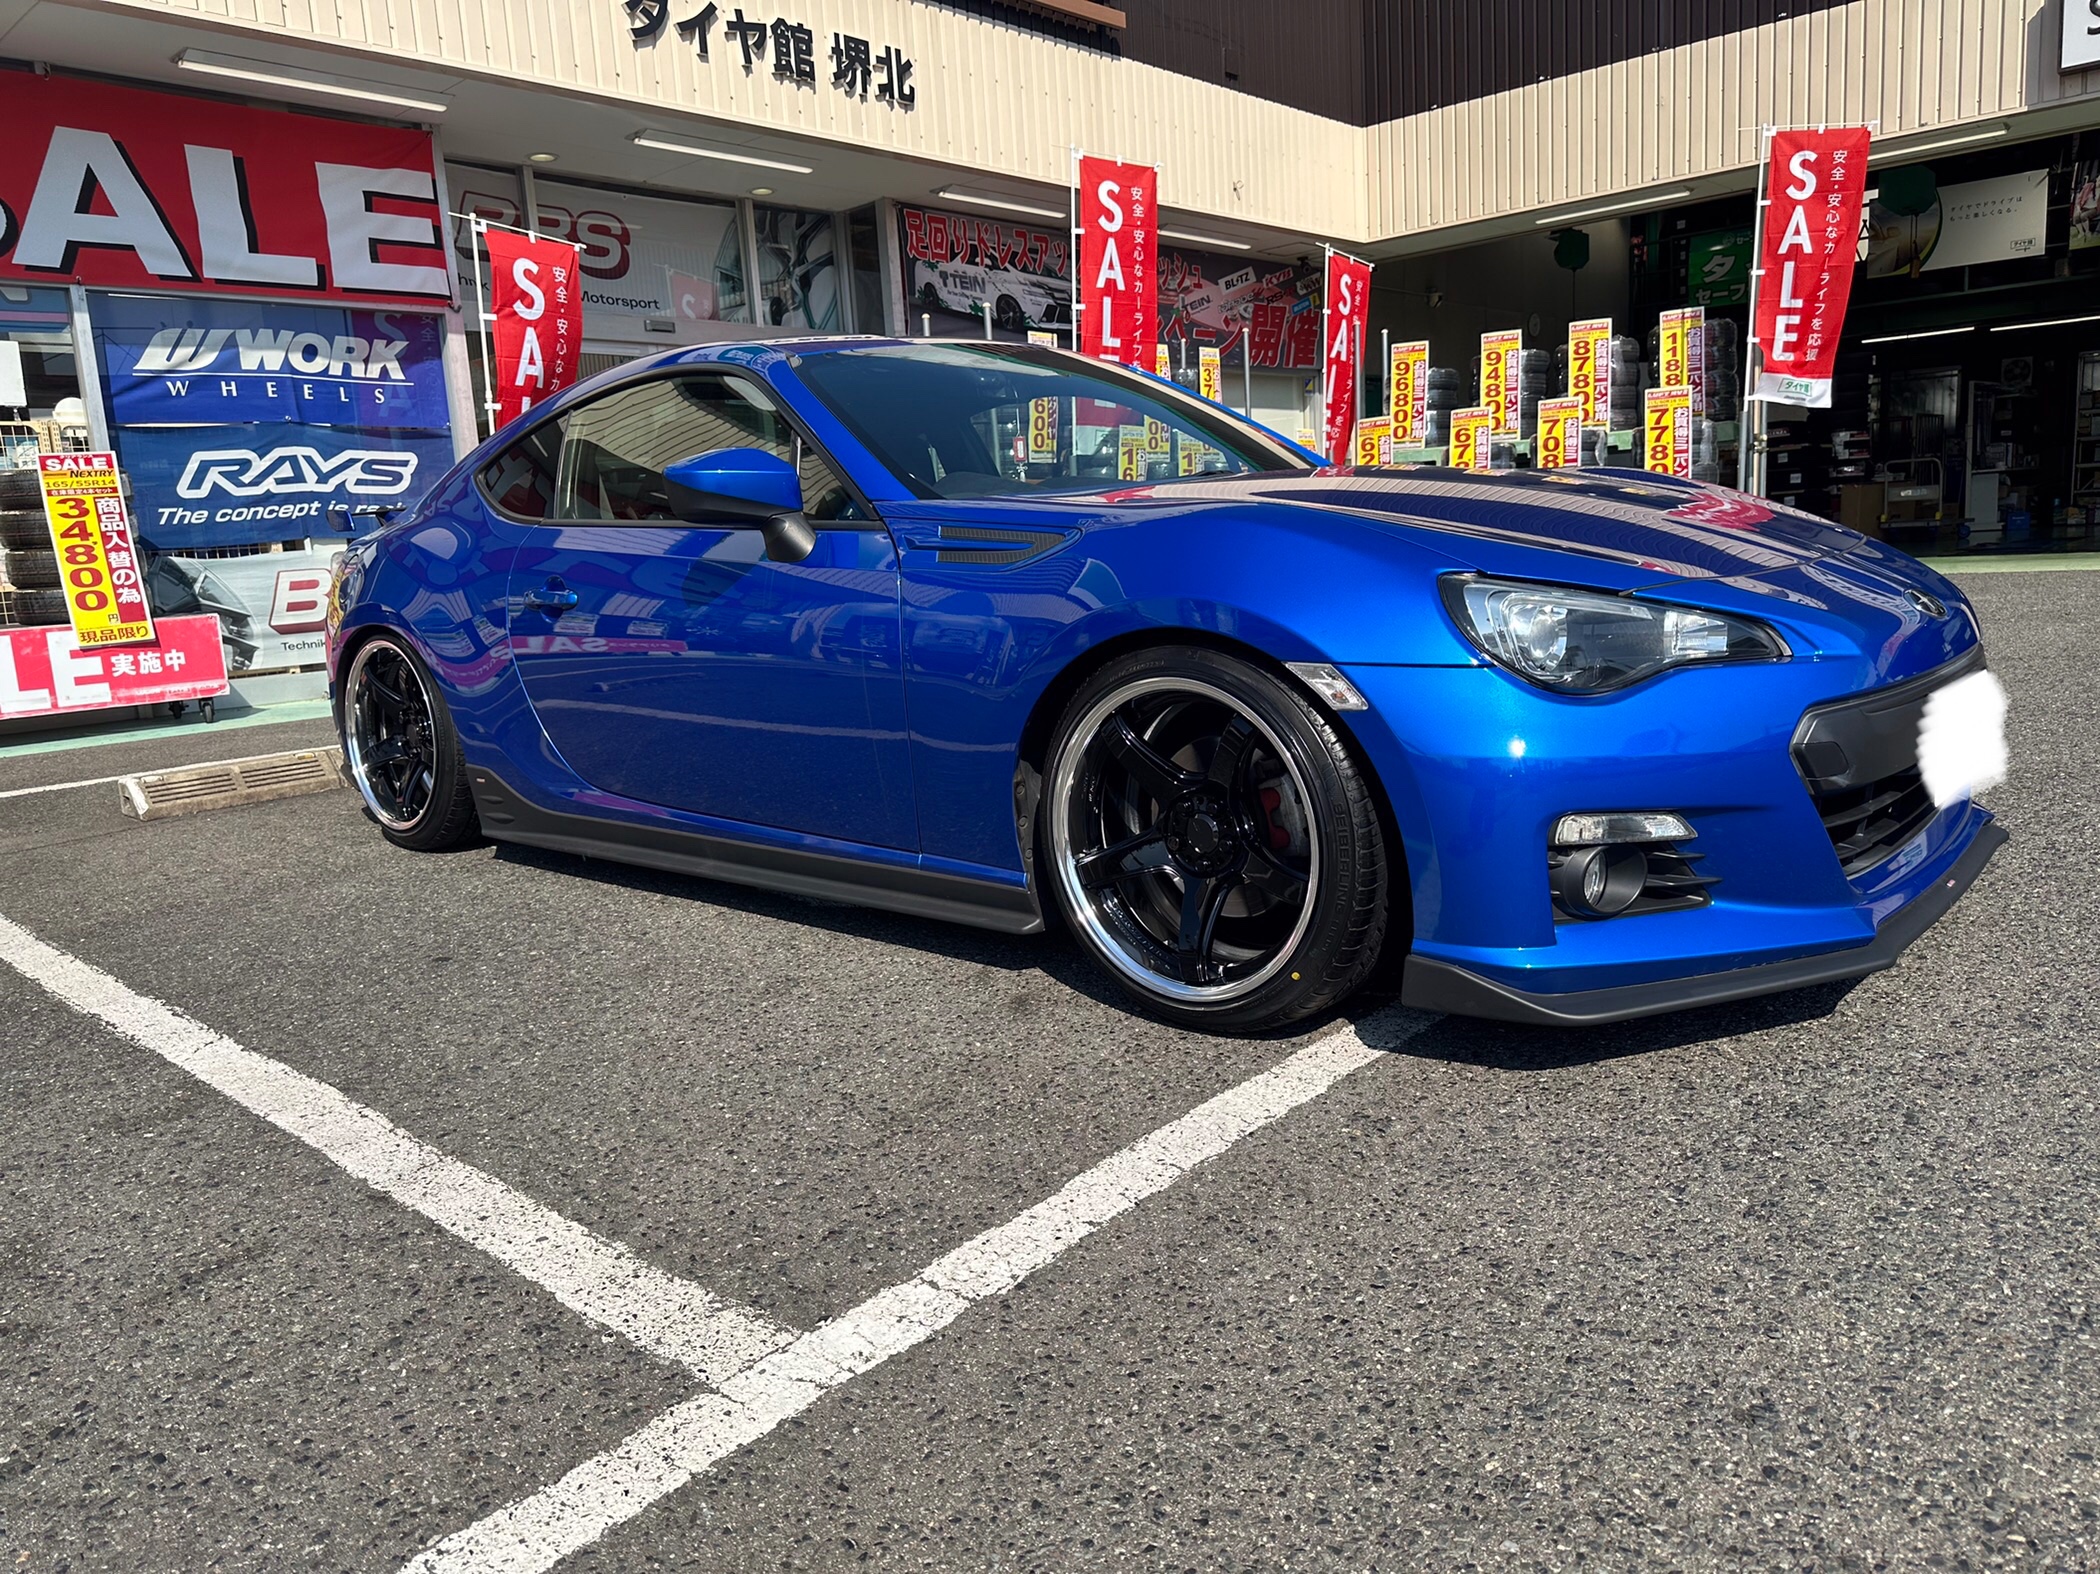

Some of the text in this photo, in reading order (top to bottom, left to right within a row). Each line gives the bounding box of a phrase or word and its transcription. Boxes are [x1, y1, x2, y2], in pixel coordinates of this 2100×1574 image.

[622, 0, 916, 103] タイヤ館 堺北
[0, 124, 450, 297] ALE
[904, 209, 1068, 277] 足回りドレスアッ
[1771, 150, 1818, 361] SALE
[1804, 150, 1848, 361] 安全・安心なカーライフを応援
[949, 271, 986, 294] TEIN
[1096, 180, 1126, 362] SAL
[1696, 283, 1746, 304] セーフ
[235, 328, 411, 380] WORK
[1594, 339, 1609, 422] お買得ミニバン専用
[166, 380, 385, 404] WHEELS
[1411, 360, 1426, 439] お買得ミニバン専用
[1505, 350, 1519, 430] お買得ミニバン専用
[45, 457, 109, 471] SALE
[45, 479, 116, 488] 165/55R14
[70, 469, 114, 478] NEXTRY
[176, 446, 420, 499] RAYS
[157, 507, 210, 525] The
[214, 500, 320, 524] concept
[94, 496, 142, 604] 商品入替の為
[79, 626, 149, 643] 現品限り
[110, 649, 186, 677] 実施中
